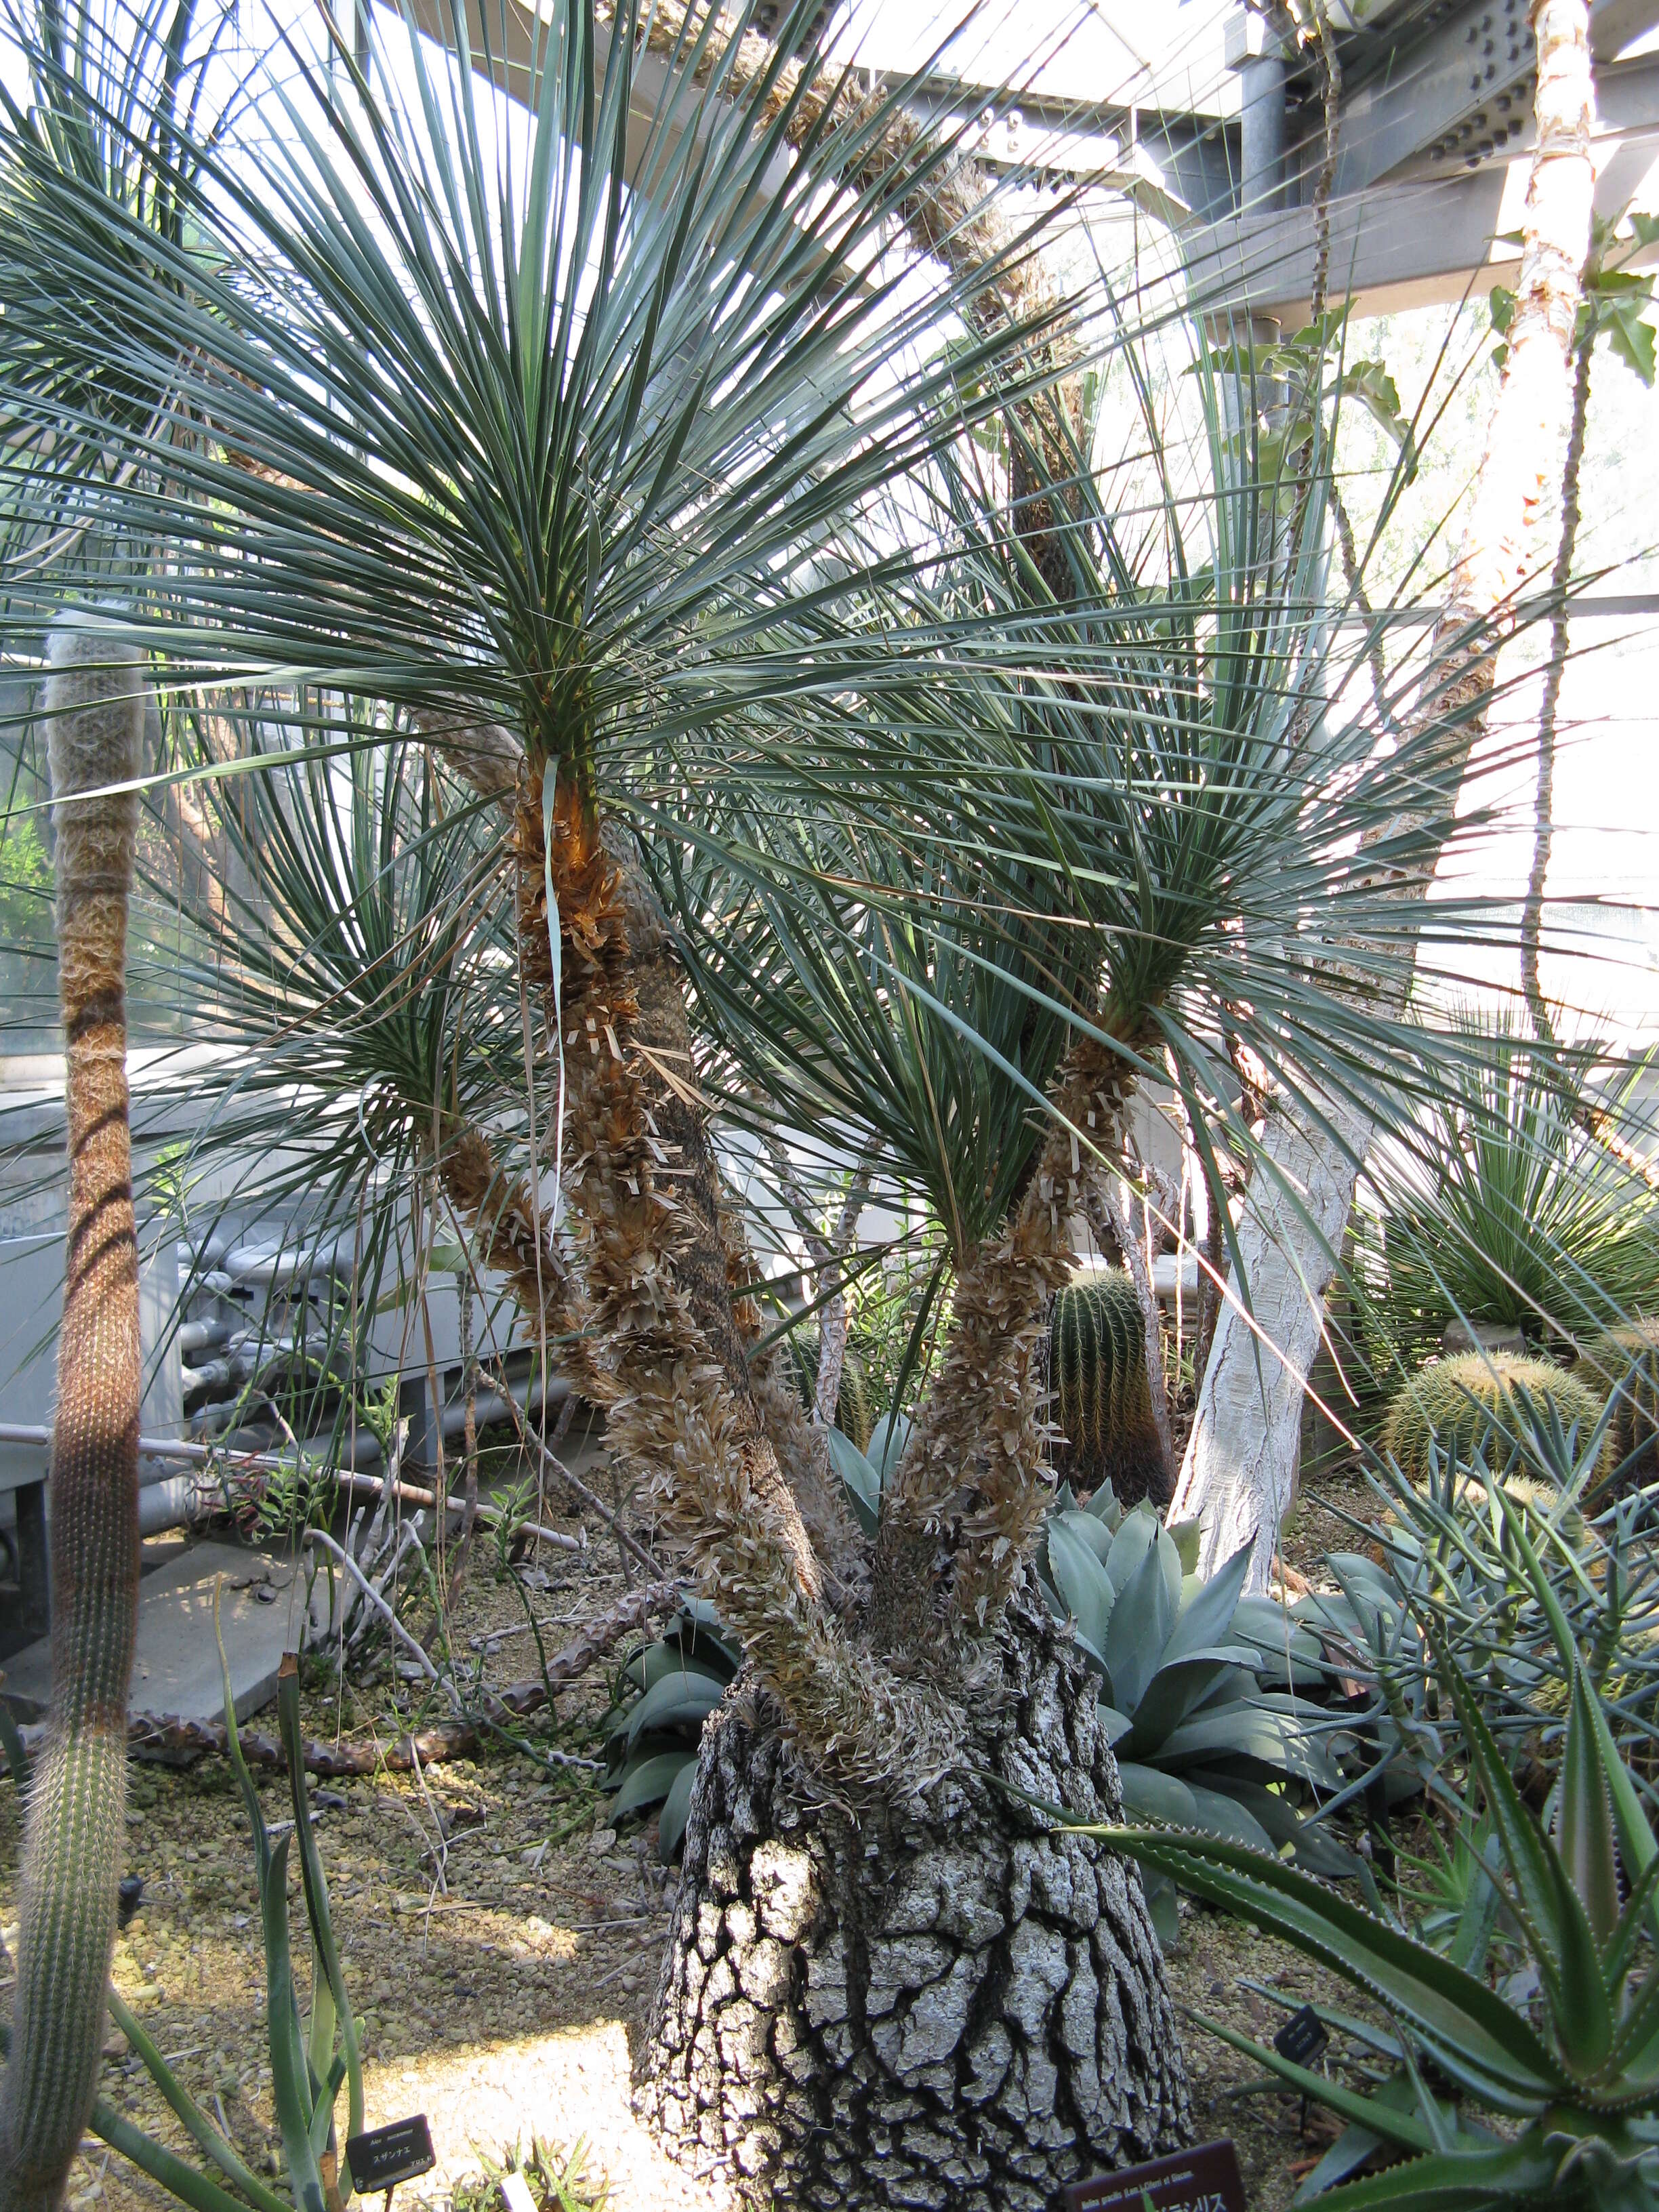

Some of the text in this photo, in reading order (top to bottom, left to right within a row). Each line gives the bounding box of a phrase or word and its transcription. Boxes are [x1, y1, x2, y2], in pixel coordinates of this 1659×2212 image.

[374, 2146, 411, 2164] スザンナエ
